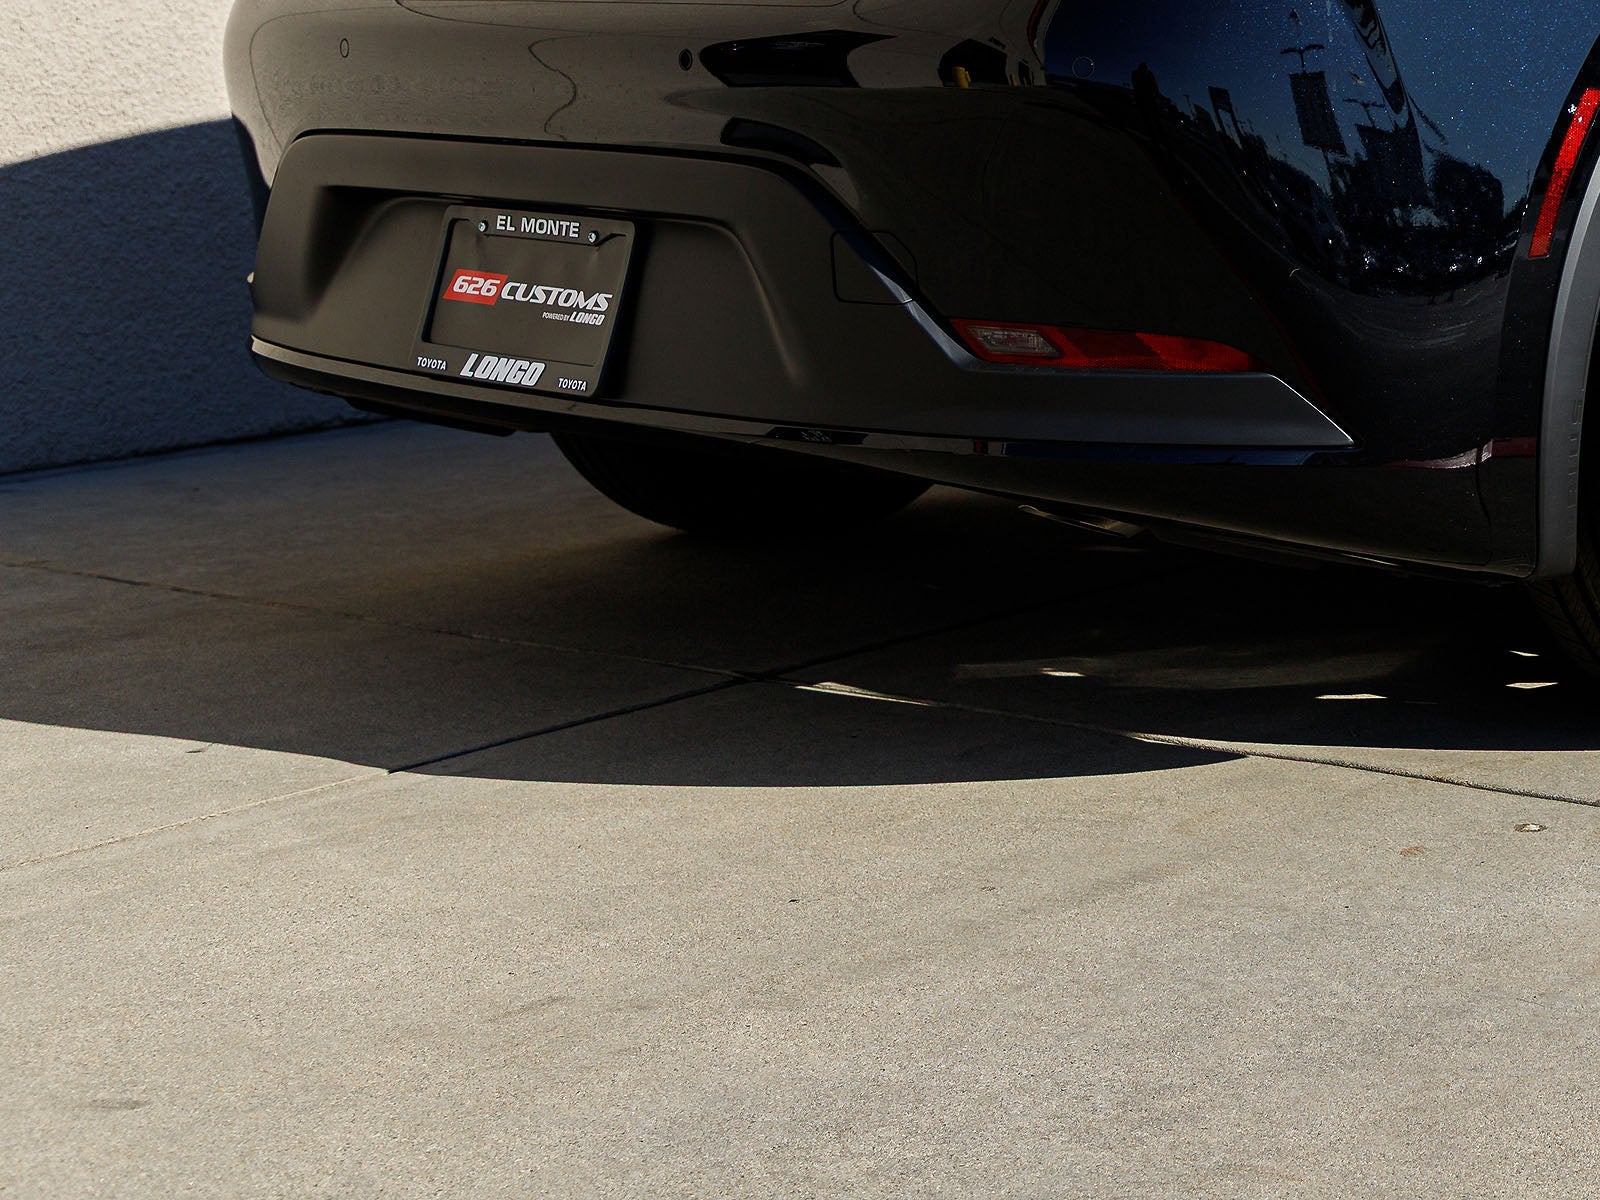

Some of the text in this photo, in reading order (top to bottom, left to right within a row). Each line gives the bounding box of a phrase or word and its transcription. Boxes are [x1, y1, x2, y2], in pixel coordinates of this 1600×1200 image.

[496, 215, 580, 238] EL MONTE
[452, 275, 613, 312] 626 CUSTOMS
[542, 311, 564, 321] POWERED
[569, 311, 605, 326] LONGO
[416, 356, 447, 371] TOYOTA
[459, 353, 547, 387] LONGO
[557, 378, 588, 392] TOYOTA
